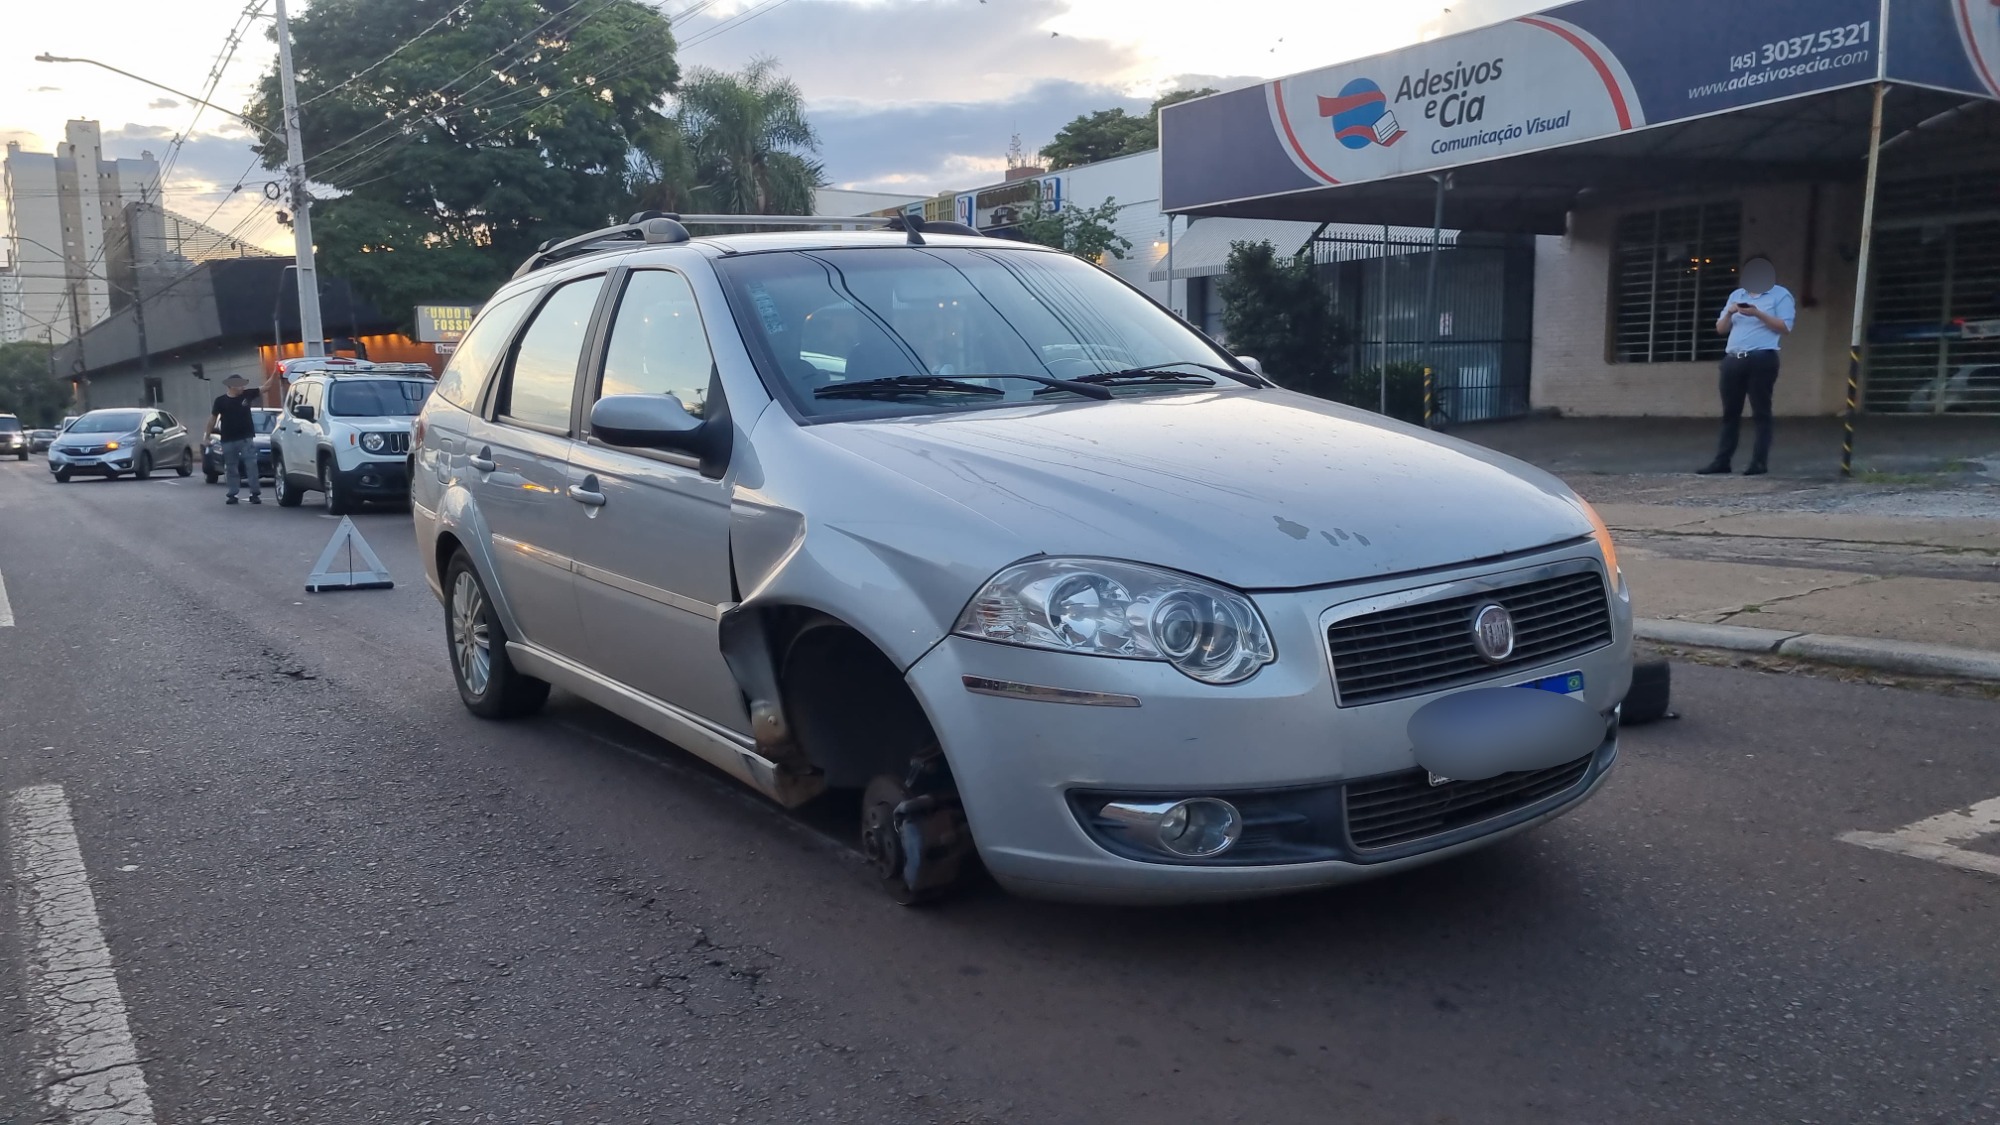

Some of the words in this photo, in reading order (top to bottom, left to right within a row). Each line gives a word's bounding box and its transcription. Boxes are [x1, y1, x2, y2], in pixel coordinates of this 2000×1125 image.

[1730, 52, 1756, 72] [45]
[1761, 21, 1870, 65] 3037.5321
[1394, 58, 1503, 103] Adesivos
[1688, 50, 1869, 99] www.adesivosecia.com
[1424, 100, 1437, 119] e
[1439, 90, 1485, 128] Cia
[1431, 124, 1522, 155] Comunicação
[1526, 110, 1571, 135] Visual
[425, 307, 461, 319] FUNDO
[434, 319, 470, 331] FOSSO
